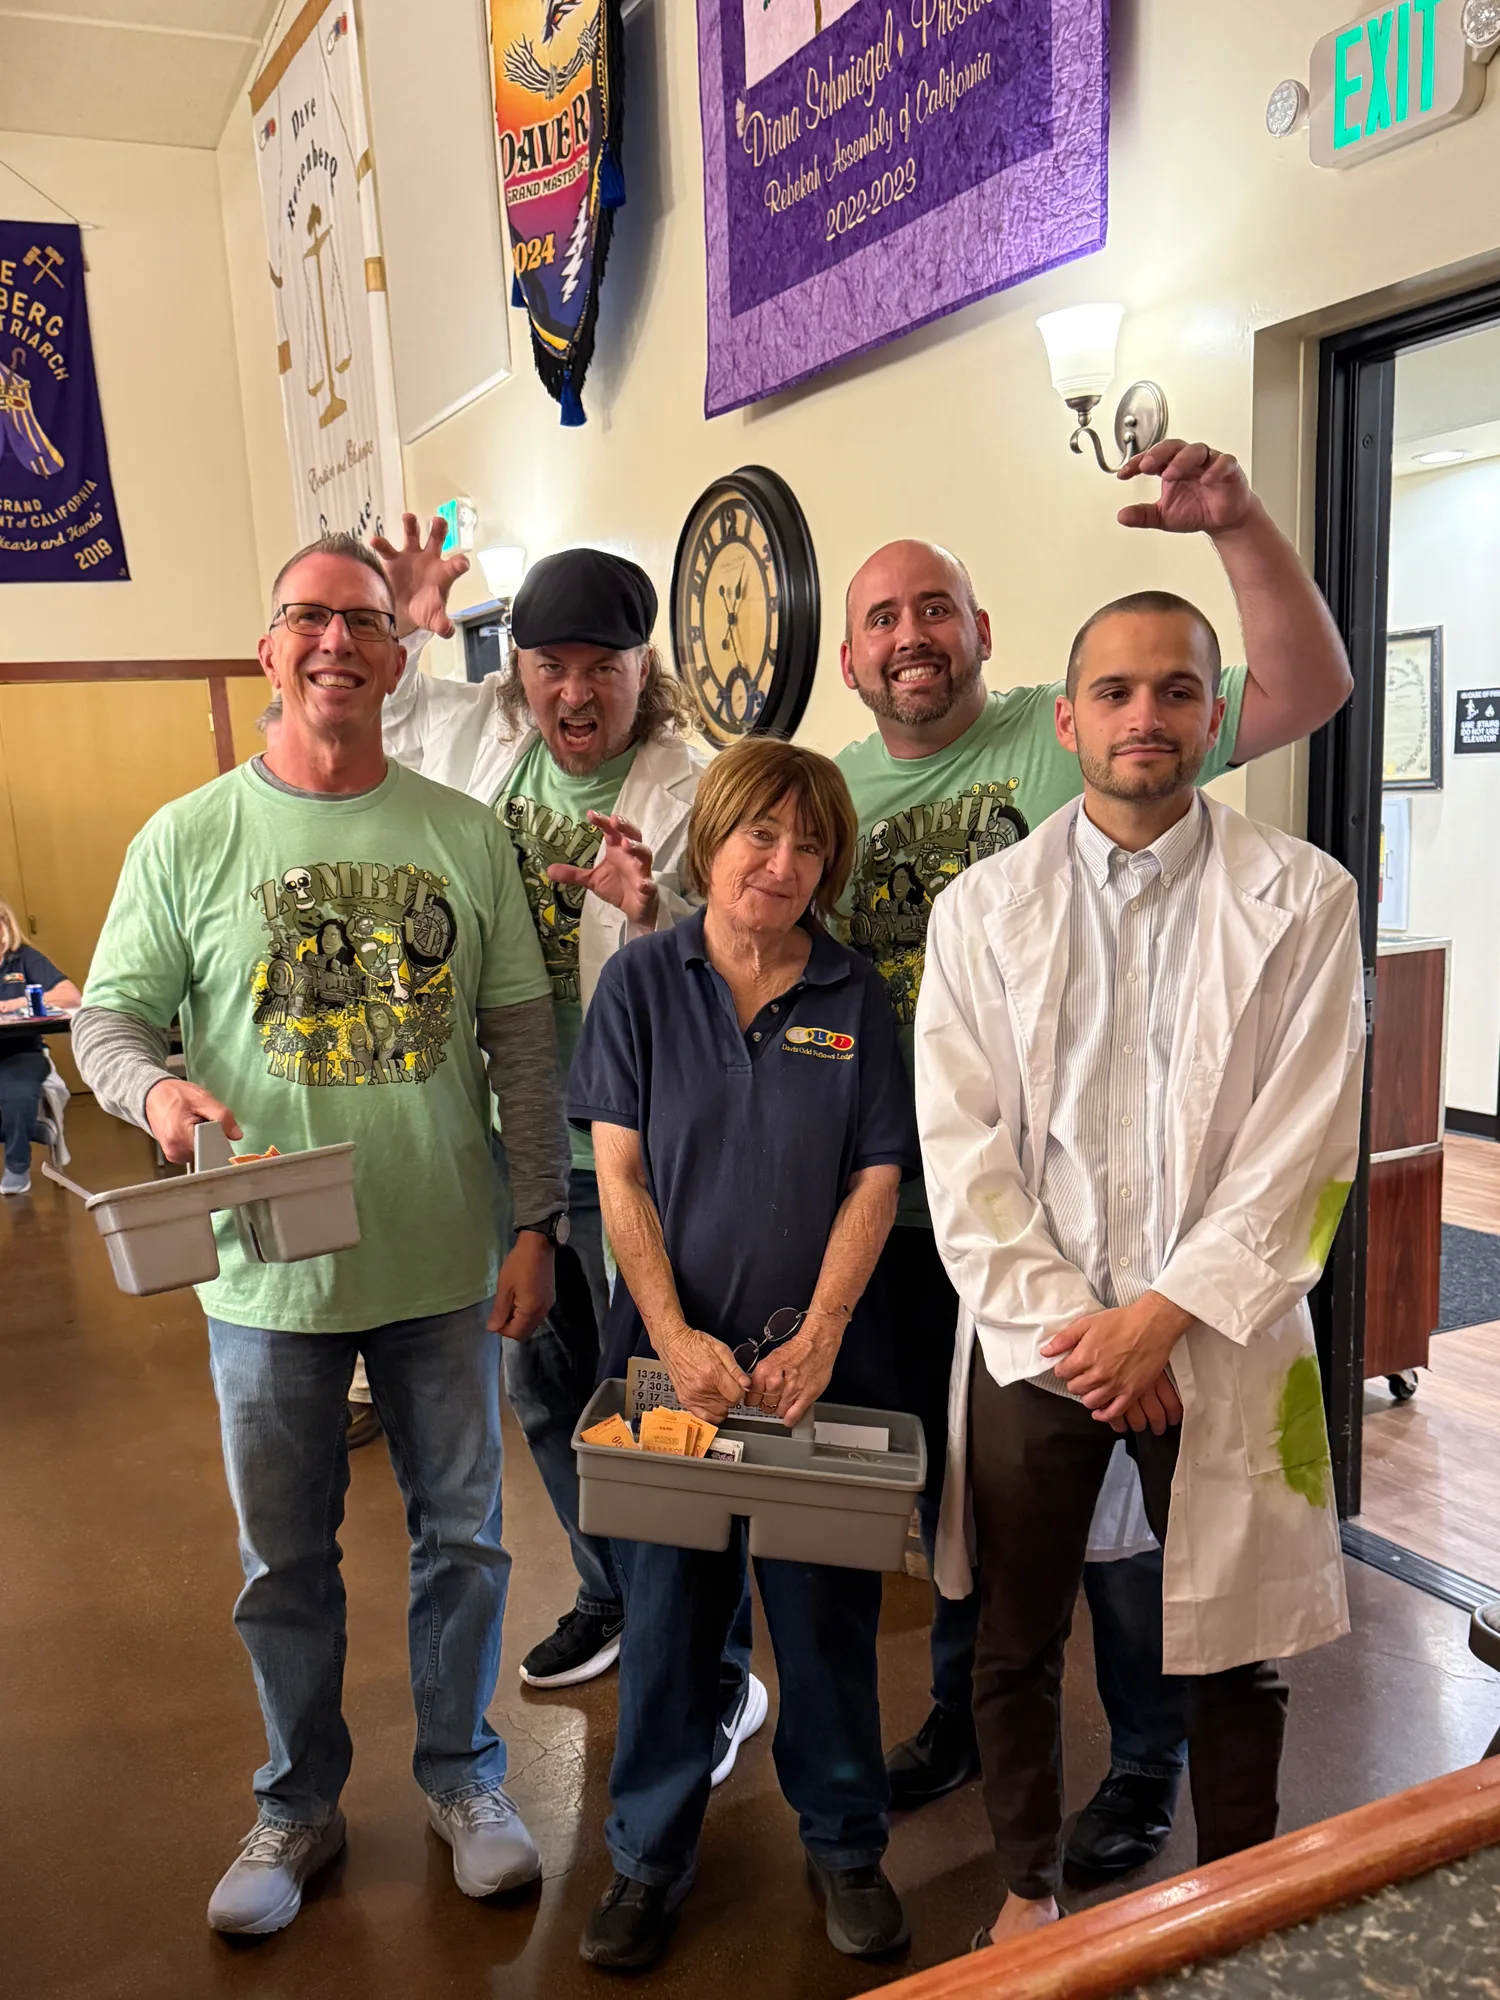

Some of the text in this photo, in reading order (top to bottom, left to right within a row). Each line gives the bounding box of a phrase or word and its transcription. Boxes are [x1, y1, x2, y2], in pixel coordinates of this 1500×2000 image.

[743, 107, 801, 168] Diana
[806, 9, 892, 130] Schmiegel
[1334, 0, 1443, 150] EXIT
[500, 110, 572, 180] DAVE
[765, 52, 991, 217] Rebekah Assembly of California
[542, 165, 577, 194] MASTER
[826, 157, 916, 242] 2022-2023
[512, 232, 556, 274] 024
[30, 479, 98, 529] CALIFORNIA
[40, 531, 67, 550] and
[74, 538, 113, 571] 2019
[267, 1050, 340, 1087] BIKE
[637, 1369, 670, 1381] 13 28 3
[638, 1381, 645, 1389] 7
[649, 1382, 662, 1391] 30
[635, 1402, 646, 1411] 10
[637, 1391, 660, 1402] 9 17
